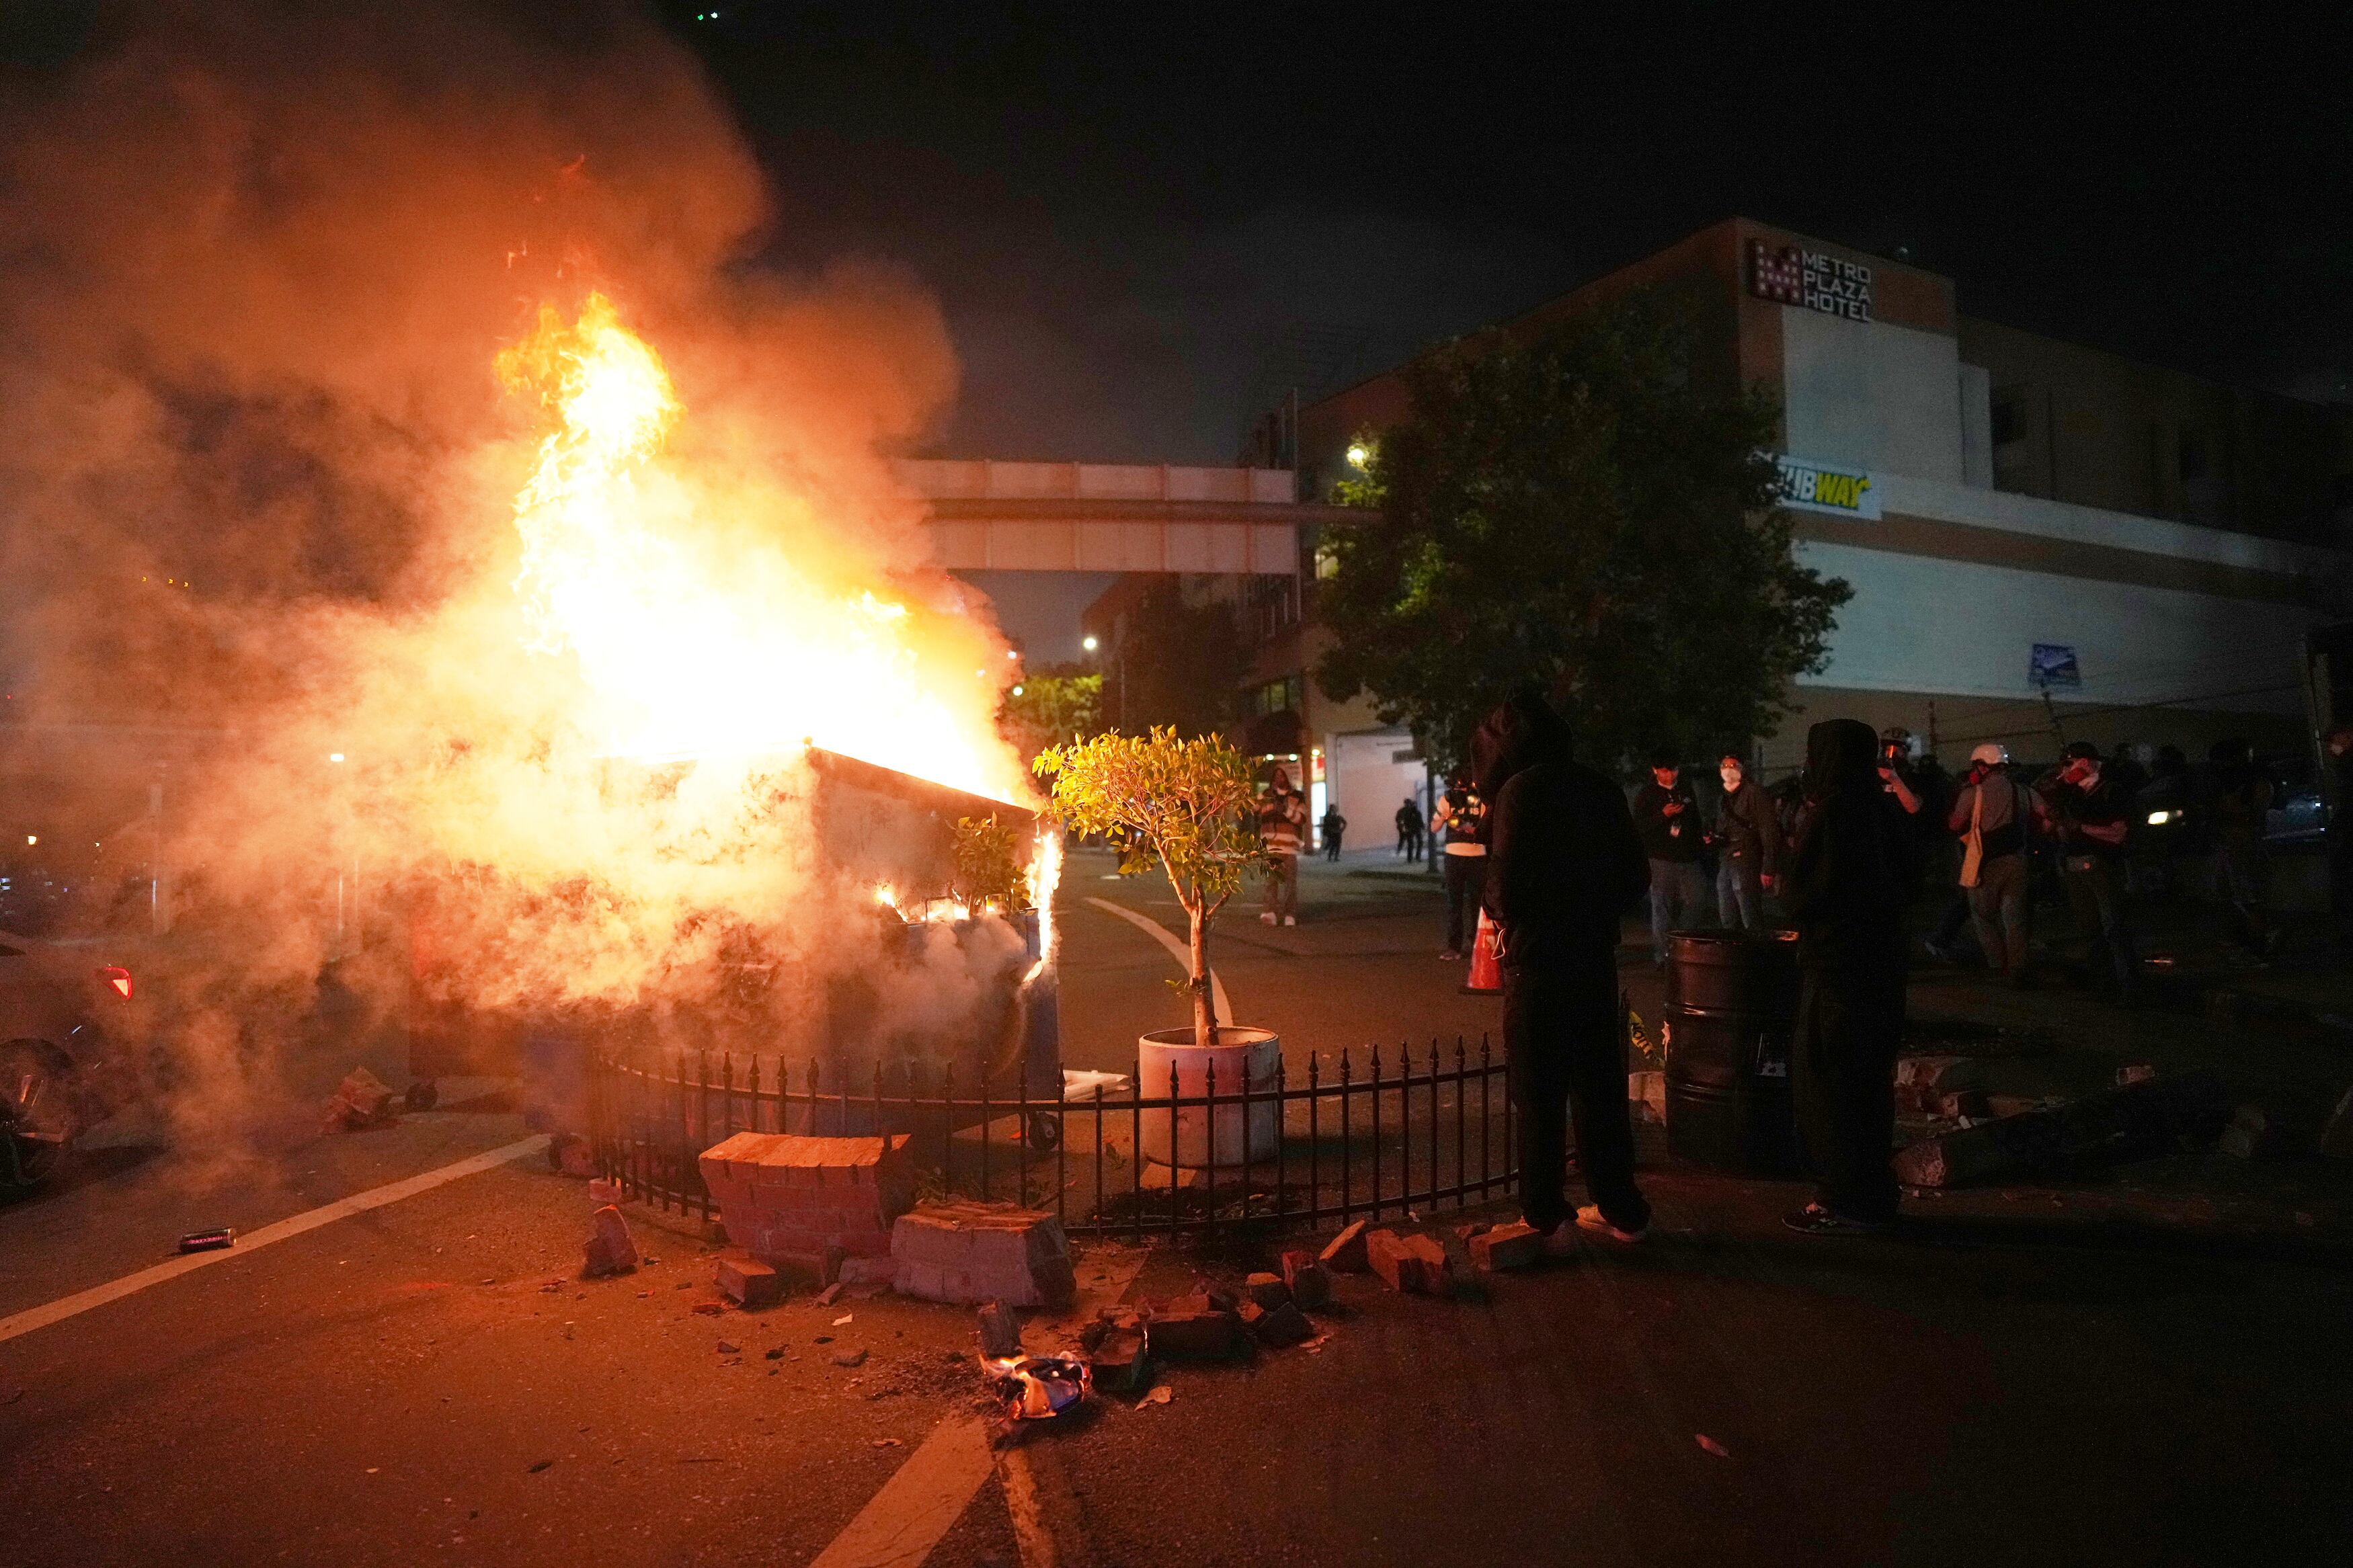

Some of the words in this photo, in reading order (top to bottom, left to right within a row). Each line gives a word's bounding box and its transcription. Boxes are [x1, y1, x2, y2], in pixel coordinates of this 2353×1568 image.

[1802, 249, 1871, 284] METRO
[1803, 269, 1872, 303] PLAZA
[1804, 290, 1872, 321] HOTEL
[1777, 465, 1871, 509] UBWAY
